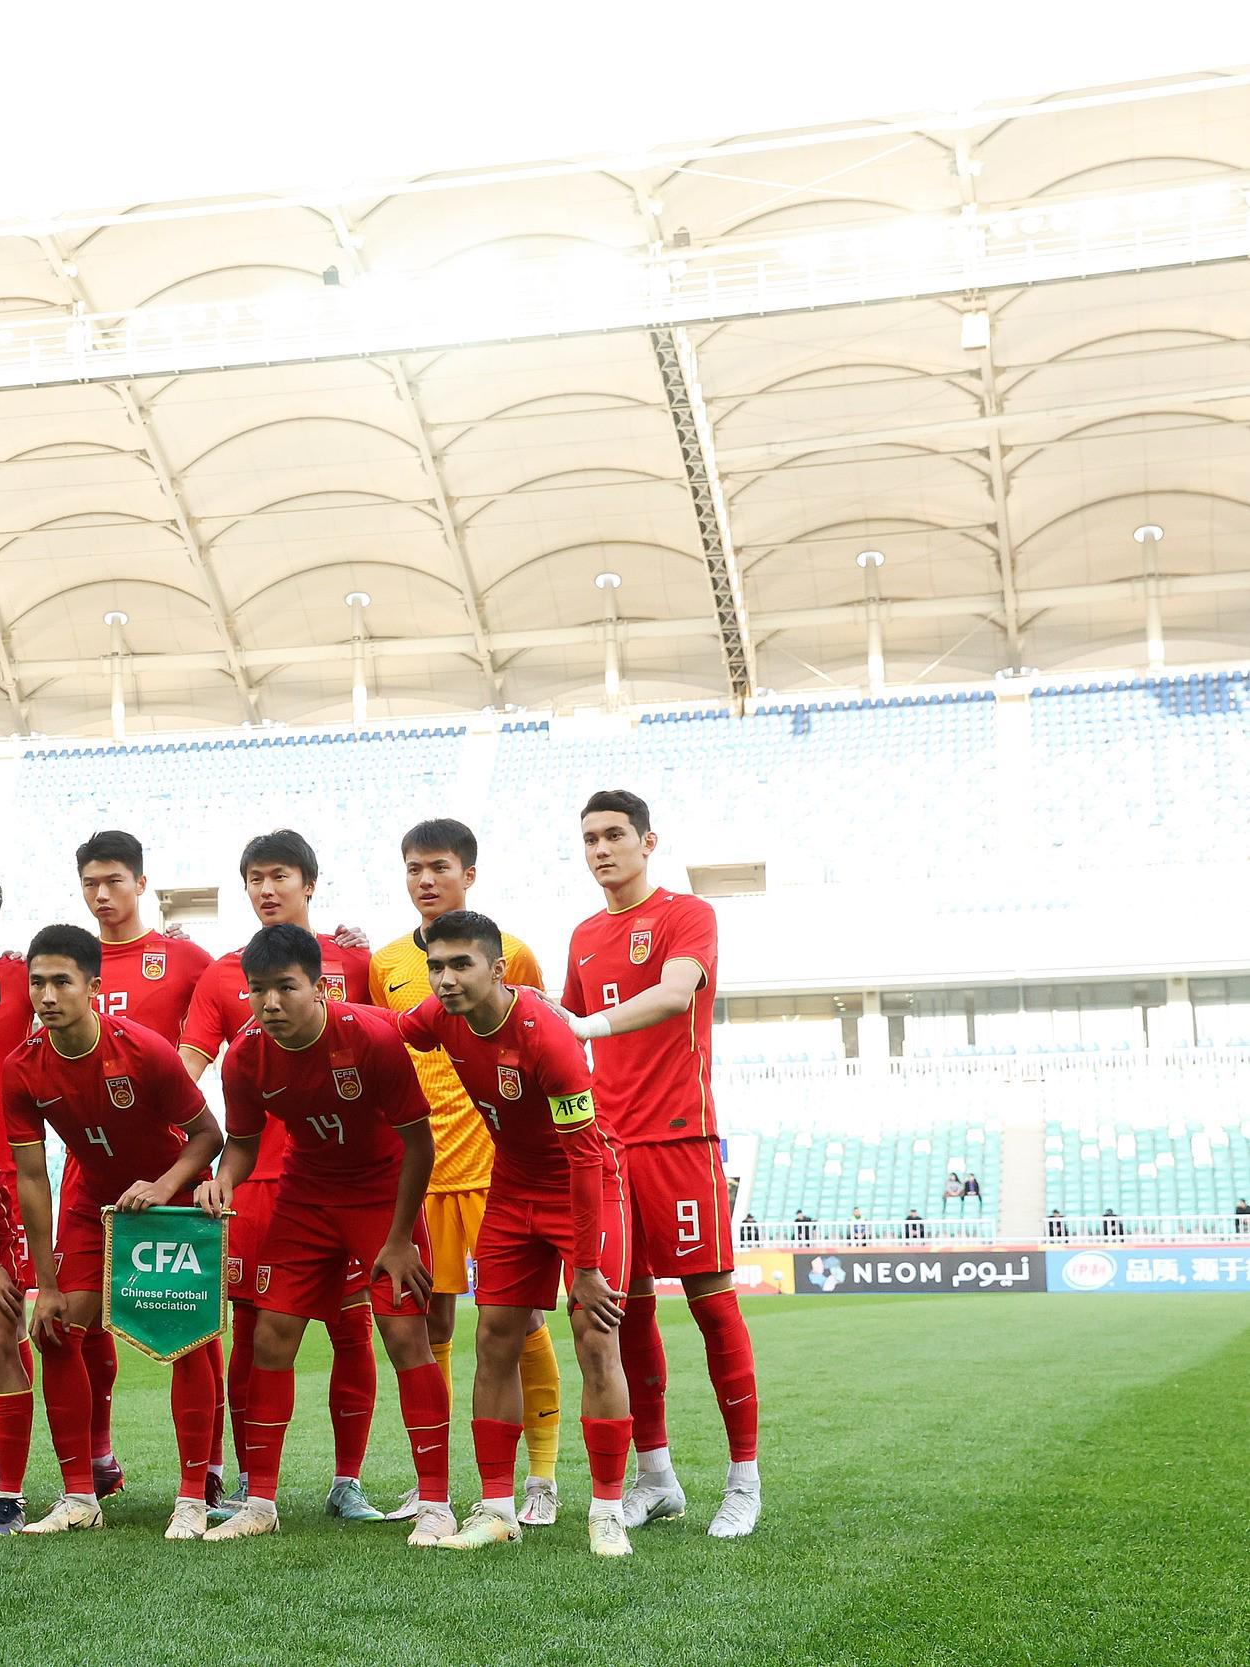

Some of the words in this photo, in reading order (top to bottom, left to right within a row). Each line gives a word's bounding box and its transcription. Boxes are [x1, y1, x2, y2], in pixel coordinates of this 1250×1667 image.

[555, 1095, 590, 1117] AFC
[85, 1126, 114, 1157] 4
[306, 1114, 345, 1145] 14
[676, 1200, 701, 1242] 9
[131, 1241, 202, 1275] CFA
[853, 1262, 942, 1284] NEOM
[952, 1256, 1030, 1287] نيوم
[121, 1288, 163, 1299] Chinese
[165, 1289, 208, 1301] Football
[134, 1300, 197, 1311] Association
